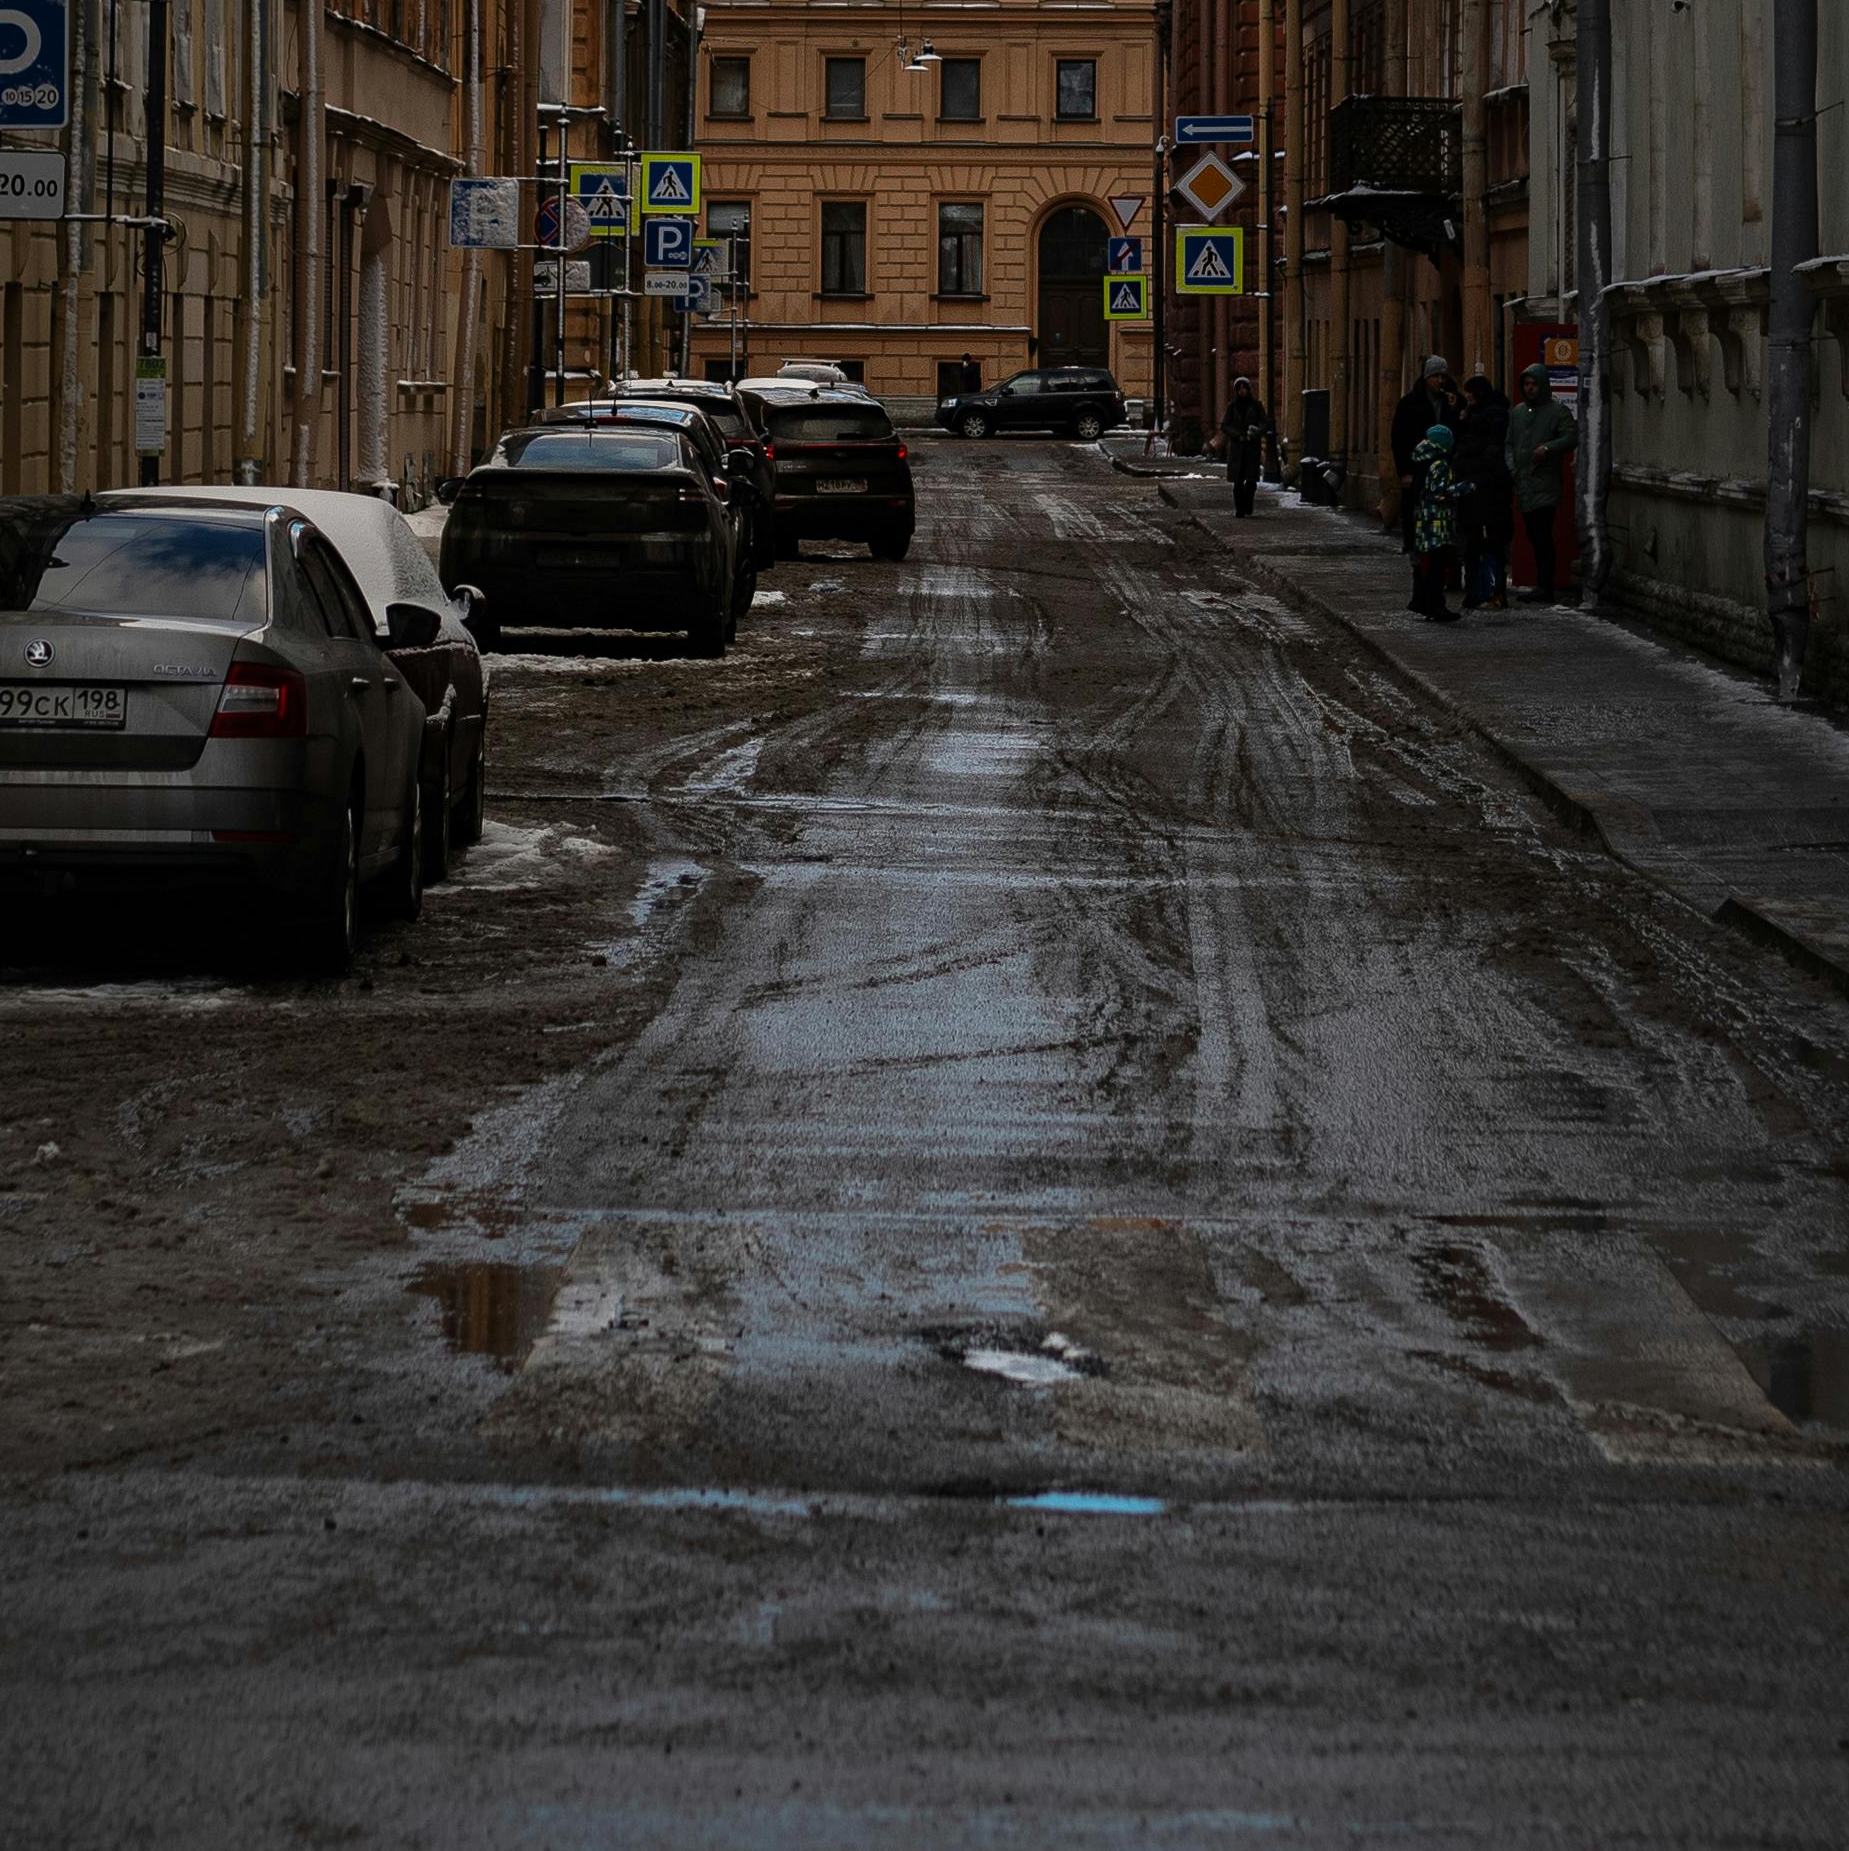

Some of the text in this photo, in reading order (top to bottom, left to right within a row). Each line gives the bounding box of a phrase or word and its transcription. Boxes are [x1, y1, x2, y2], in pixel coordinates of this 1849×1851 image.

[4, 90, 57, 105] 10 15 20
[657, 226, 683, 261] P
[153, 664, 218, 678] OCTAVIA
[77, 690, 119, 711] 198
[84, 710, 105, 718] RUS
